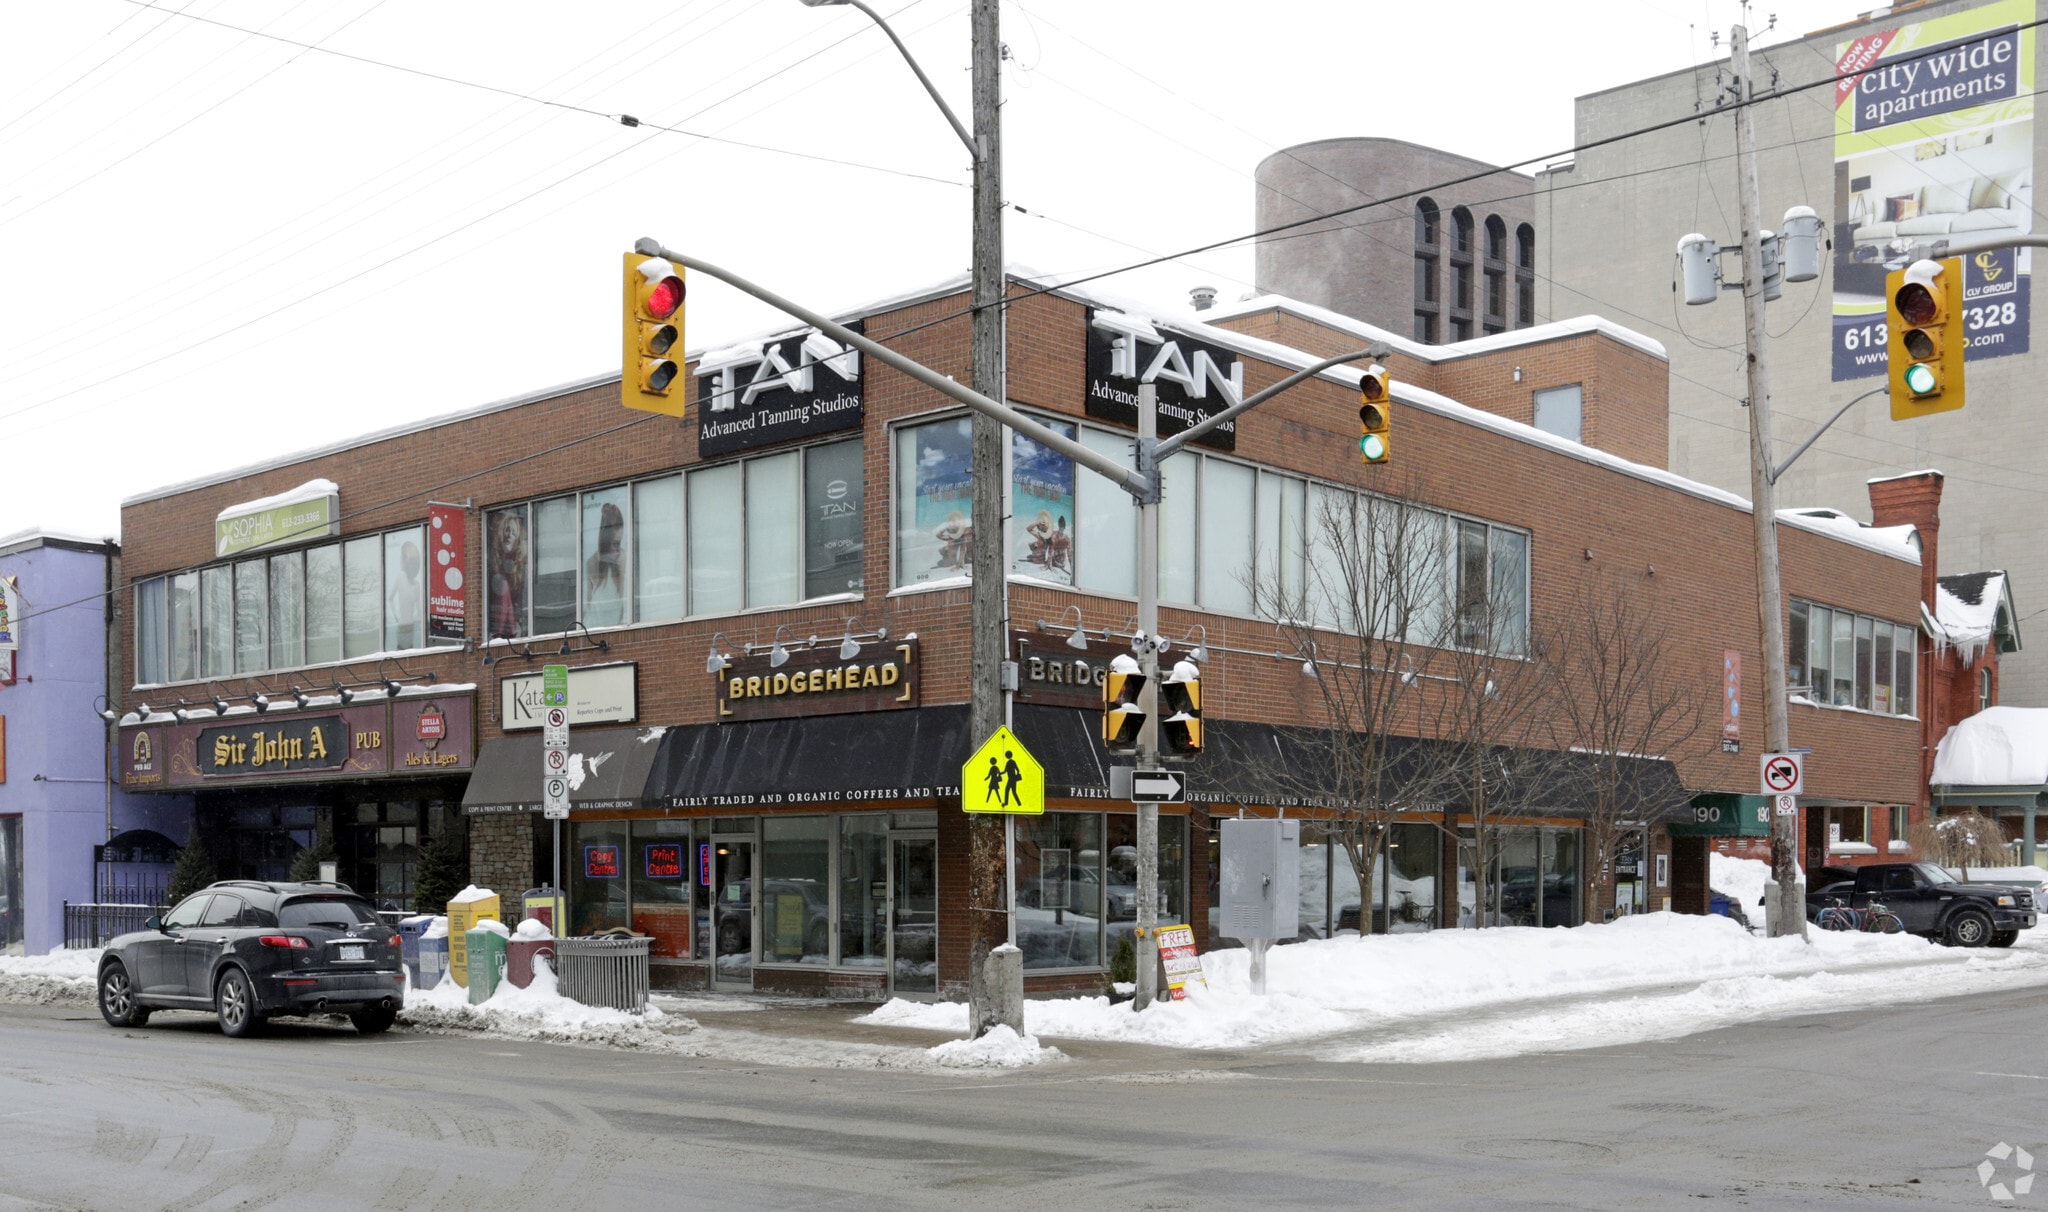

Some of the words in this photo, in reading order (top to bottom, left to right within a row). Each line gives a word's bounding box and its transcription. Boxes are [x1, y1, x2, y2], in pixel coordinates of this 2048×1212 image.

[1839, 42, 1864, 73] NOW
[1861, 62, 1921, 94] city
[1927, 39, 2012, 80] wide
[1865, 72, 2006, 123] apartments
[1966, 286, 1981, 297] CLV
[1983, 282, 2013, 294] GROUP
[1844, 323, 1888, 350] 613
[701, 413, 756, 440] Advanced
[758, 404, 810, 424] Tanning
[813, 394, 859, 416] Studios
[233, 513, 273, 539] SOPHIA
[431, 595, 465, 607] sublime
[729, 662, 899, 699] BRIDGEHEAD
[421, 717, 440, 726] STELLA
[421, 726, 440, 734] ARTOIS
[214, 734, 246, 767] Sir
[251, 730, 303, 769] John
[308, 725, 328, 760] A
[356, 731, 381, 749] PUB
[405, 752, 421, 766] Ales
[433, 752, 458, 767] Lagers
[672, 796, 708, 807] FAIRLY
[712, 794, 755, 806] TRADED
[759, 793, 782, 804] AND
[788, 791, 840, 802] ORGANIC
[846, 788, 899, 800] COFFEES
[904, 786, 930, 798] AND
[1070, 787, 1109, 799] FAIRLY
[1186, 792, 1232, 803] ORGANIC
[1279, 797, 1298, 806] AND
[1757, 806, 1769, 823] 190
[590, 850, 614, 862] Copy
[652, 849, 675, 862] Print
[588, 863, 616, 875] Centre
[649, 863, 679, 875] Centre
